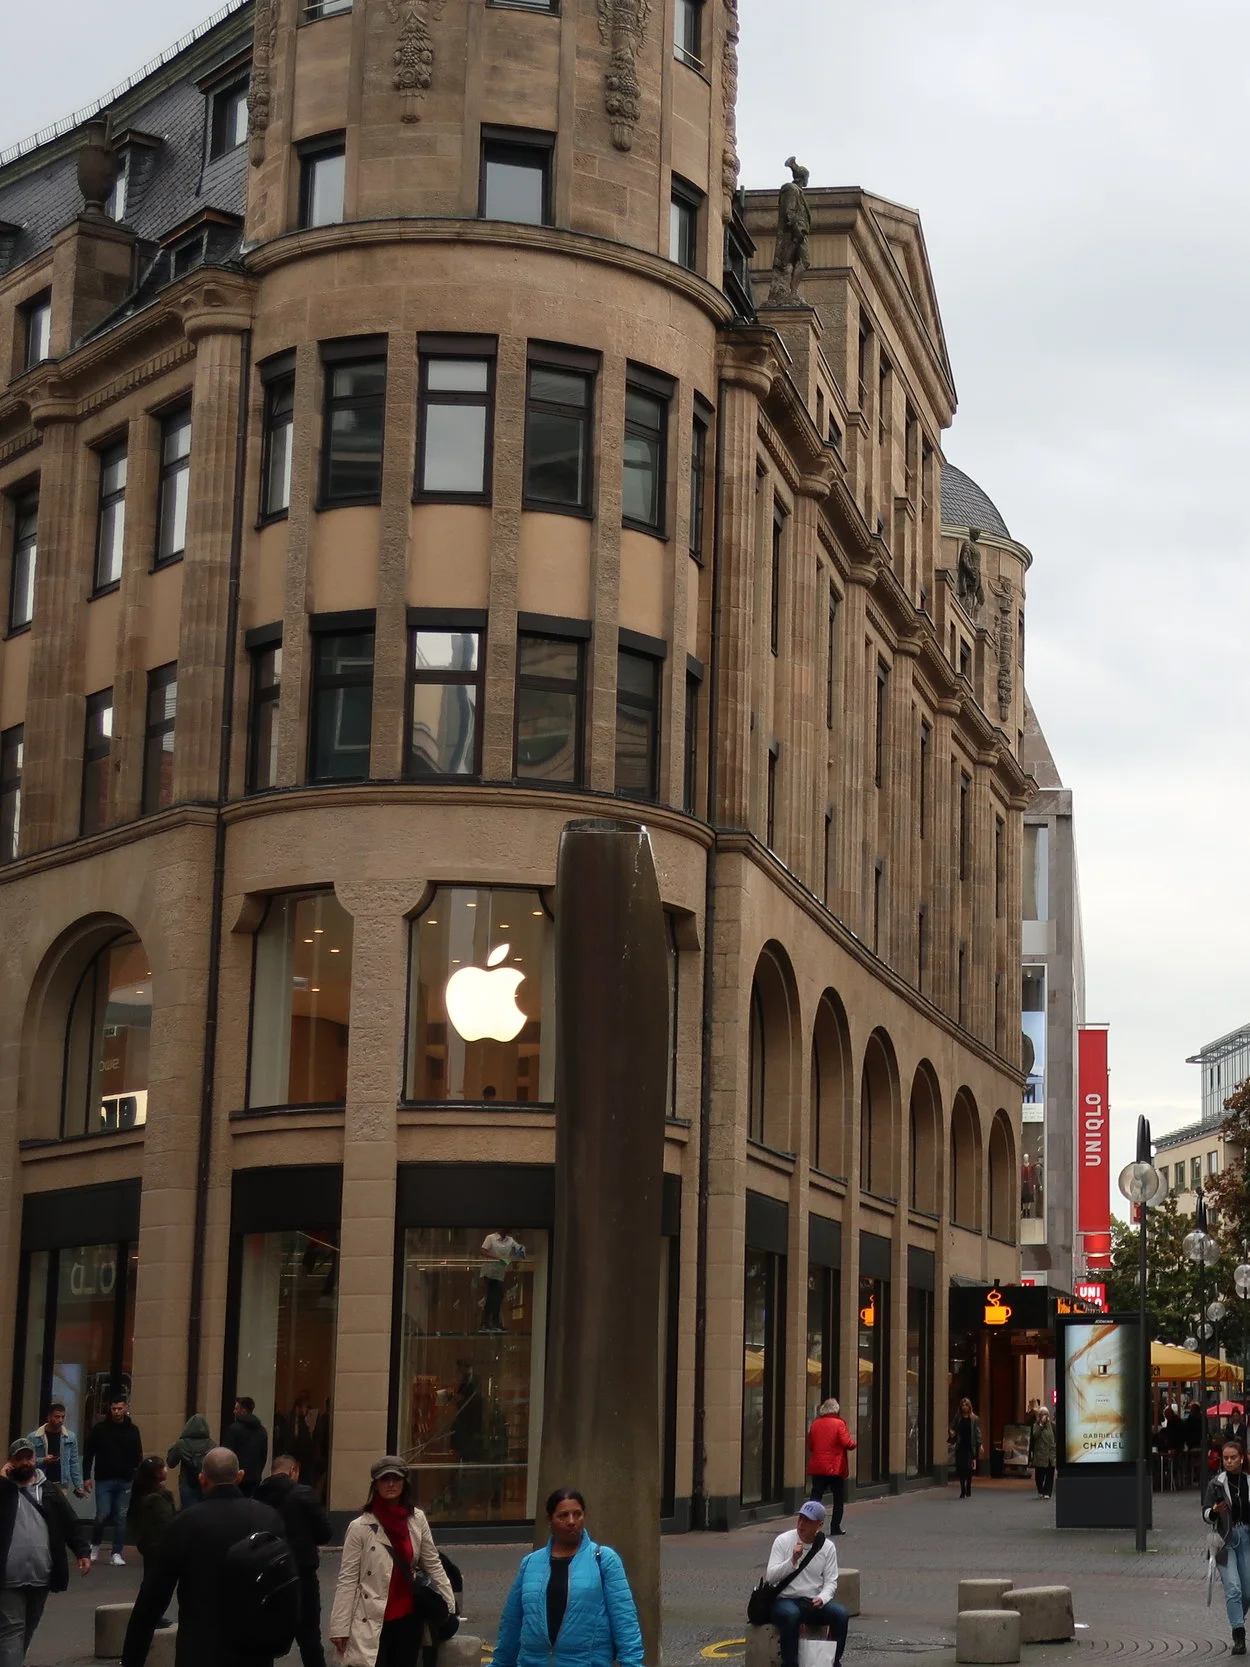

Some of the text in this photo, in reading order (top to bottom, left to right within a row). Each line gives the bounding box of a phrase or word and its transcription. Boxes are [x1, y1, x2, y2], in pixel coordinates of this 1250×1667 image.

[1085, 1093, 1105, 1167] UNIQLO
[1080, 1286, 1101, 1298] UNI
[1082, 1441, 1125, 1450] CHANEL
